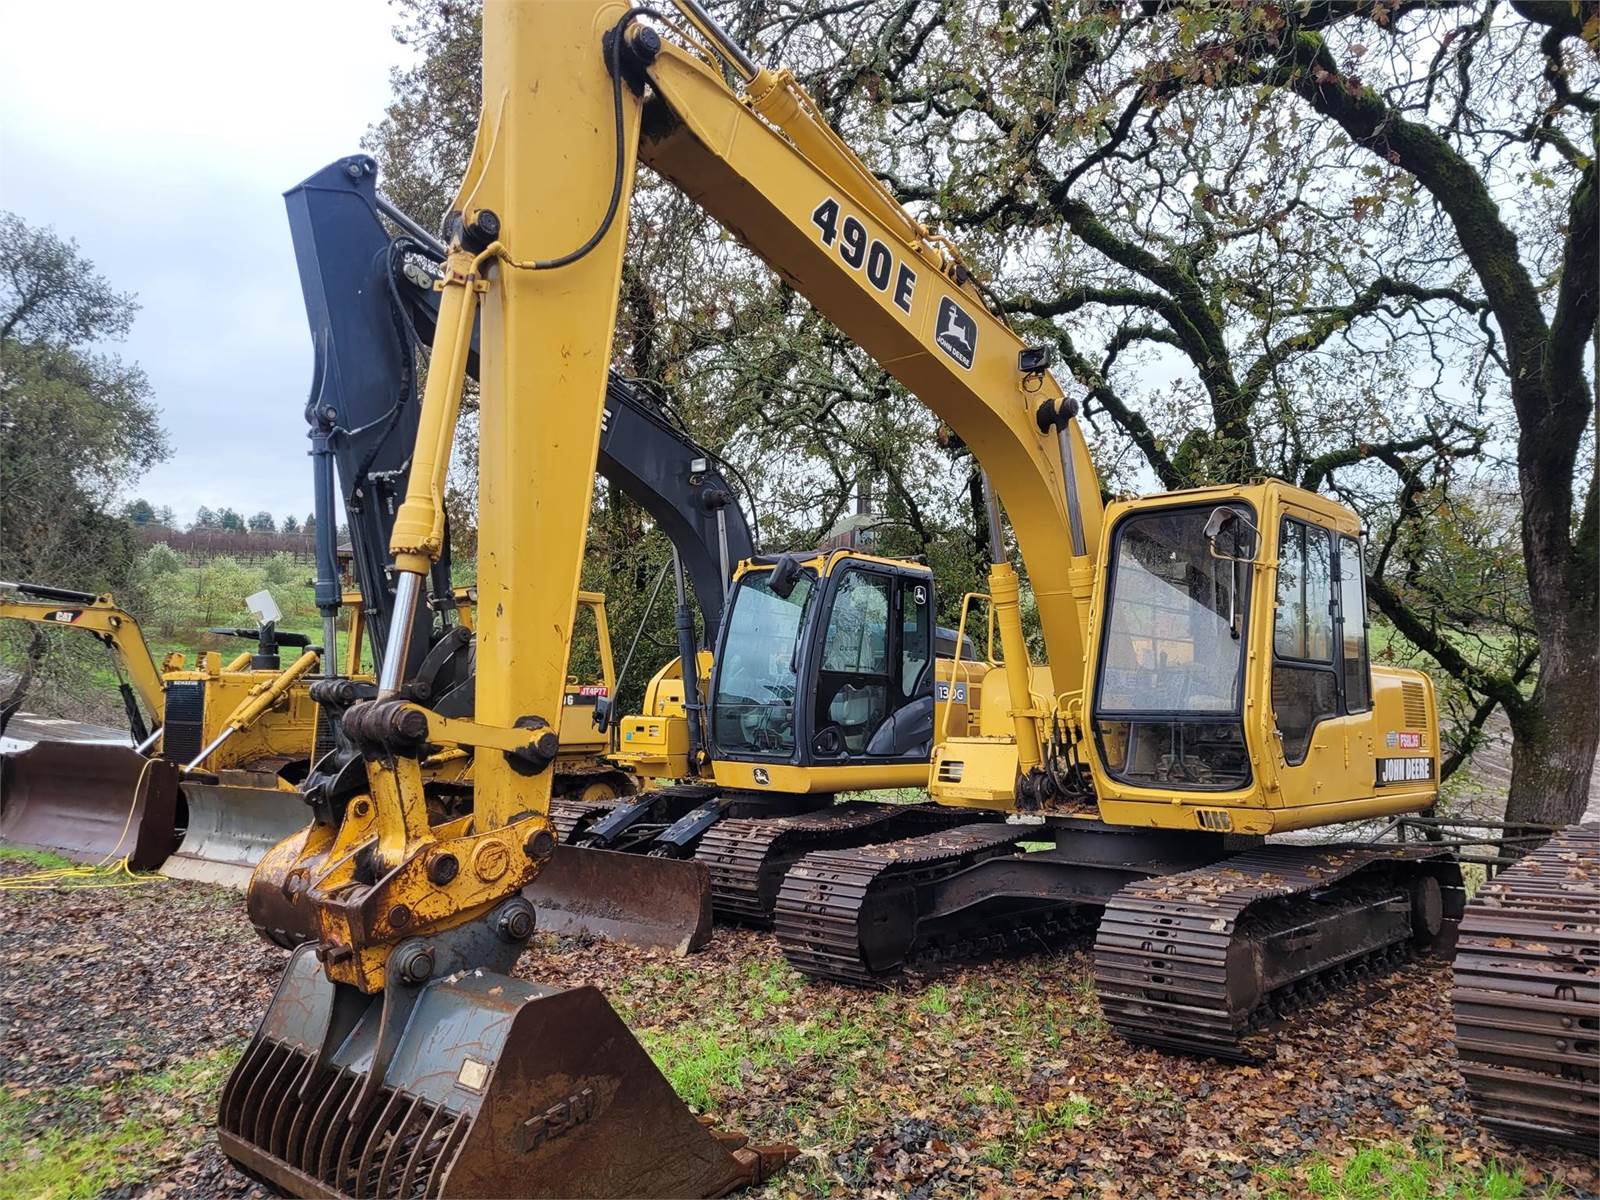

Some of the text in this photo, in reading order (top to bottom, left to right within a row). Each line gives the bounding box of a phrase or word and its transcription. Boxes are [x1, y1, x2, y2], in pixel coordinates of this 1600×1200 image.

[936, 335, 970, 367] JOHN DEERE
[55, 611, 74, 622] CAT
[1382, 758, 1430, 782] JOHN DEERE
